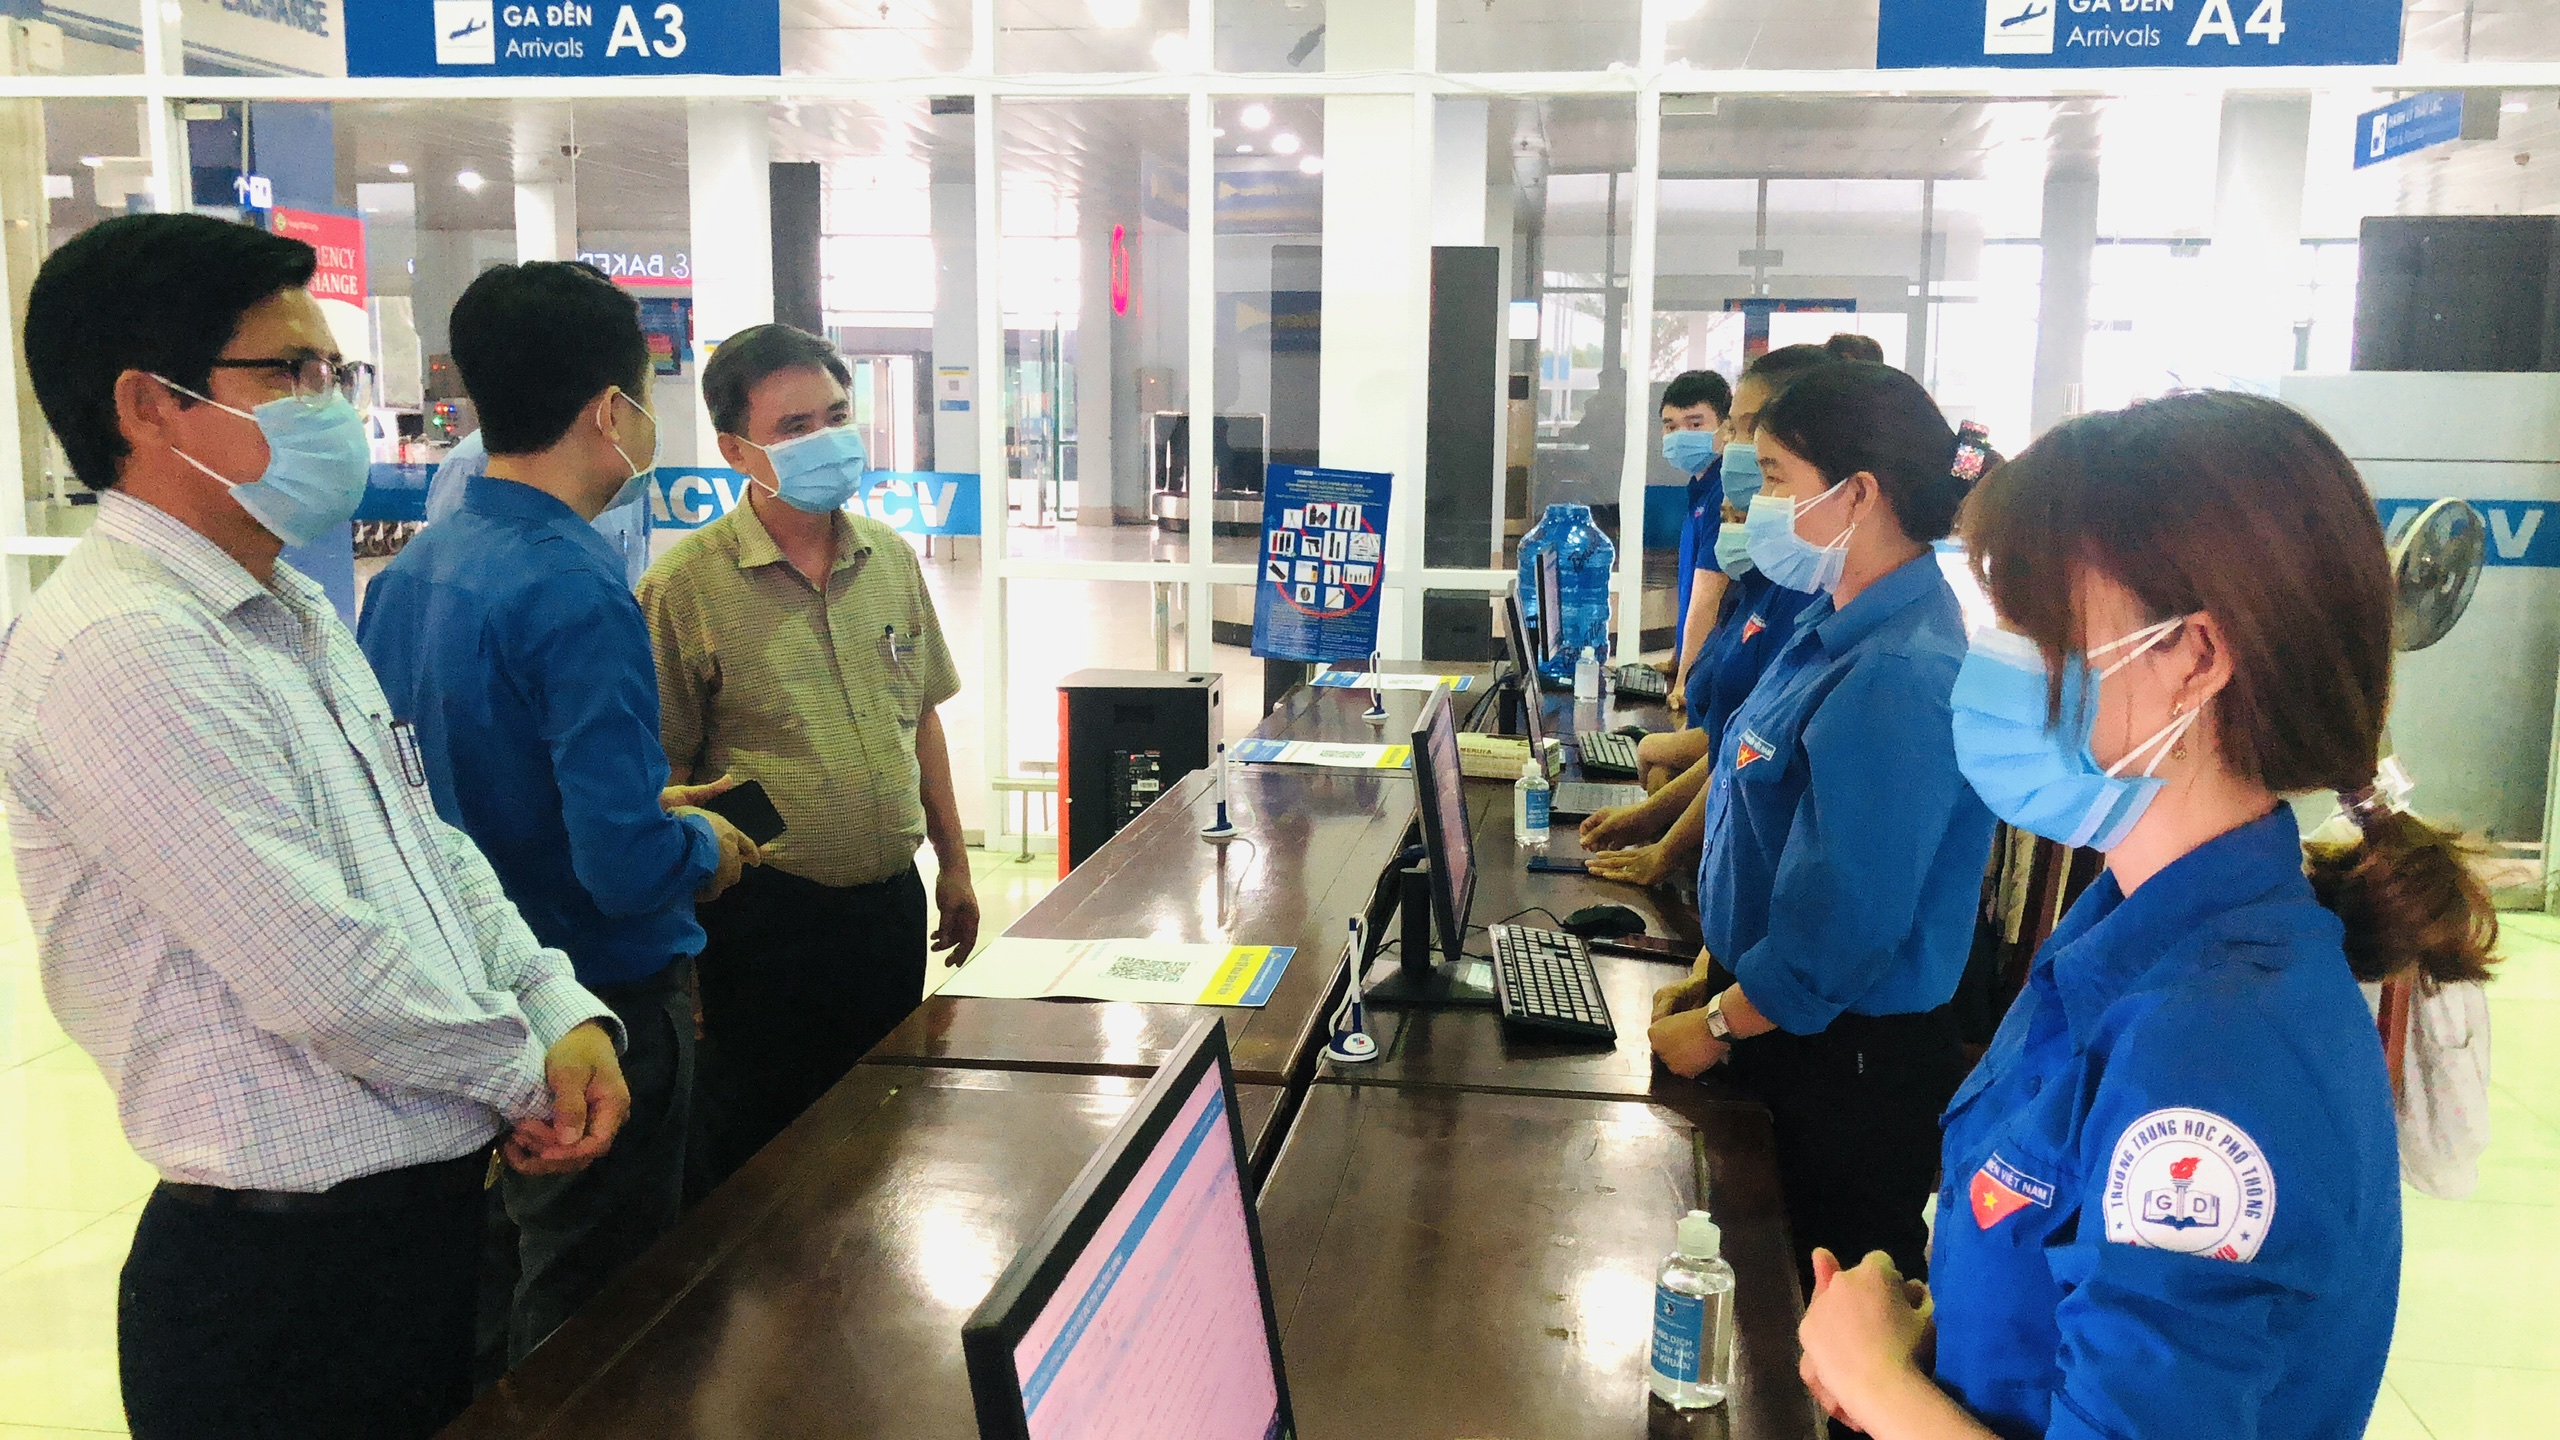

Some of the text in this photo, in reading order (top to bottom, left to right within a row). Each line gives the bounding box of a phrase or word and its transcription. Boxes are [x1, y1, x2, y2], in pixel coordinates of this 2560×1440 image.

[502, 5, 540, 27] GA
[2068, 0, 2111, 13] GA
[605, 3, 687, 58] A3
[2186, 0, 2286, 46] A4
[2066, 24, 2160, 47] Arrivals
[505, 37, 584, 58] Arrivals
[2132, 1119, 2177, 1151] TRUNG
[2184, 1120, 2217, 1142] HỌC
[2022, 1182, 2047, 1200] NAM
[2156, 1194, 2207, 1213] G D
